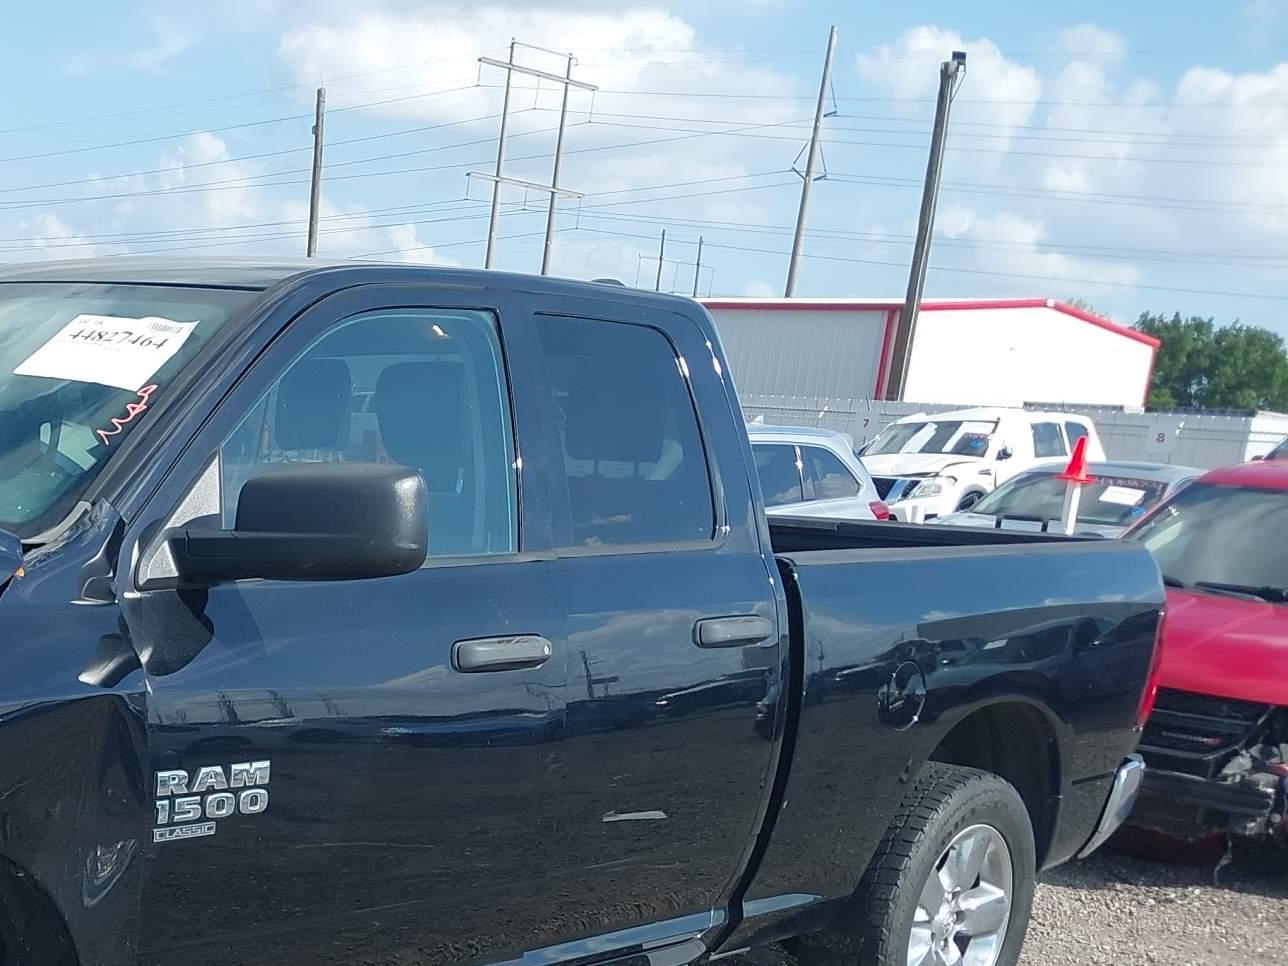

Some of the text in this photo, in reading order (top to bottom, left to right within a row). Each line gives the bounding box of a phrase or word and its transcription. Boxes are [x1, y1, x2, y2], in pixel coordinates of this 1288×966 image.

[69, 328, 169, 350] 44827464
[863, 418, 870, 428] 7
[1155, 432, 1166, 443] 8
[155, 760, 271, 797] RAM
[155, 788, 269, 825] 1500
[154, 823, 215, 841] CLASSIC
